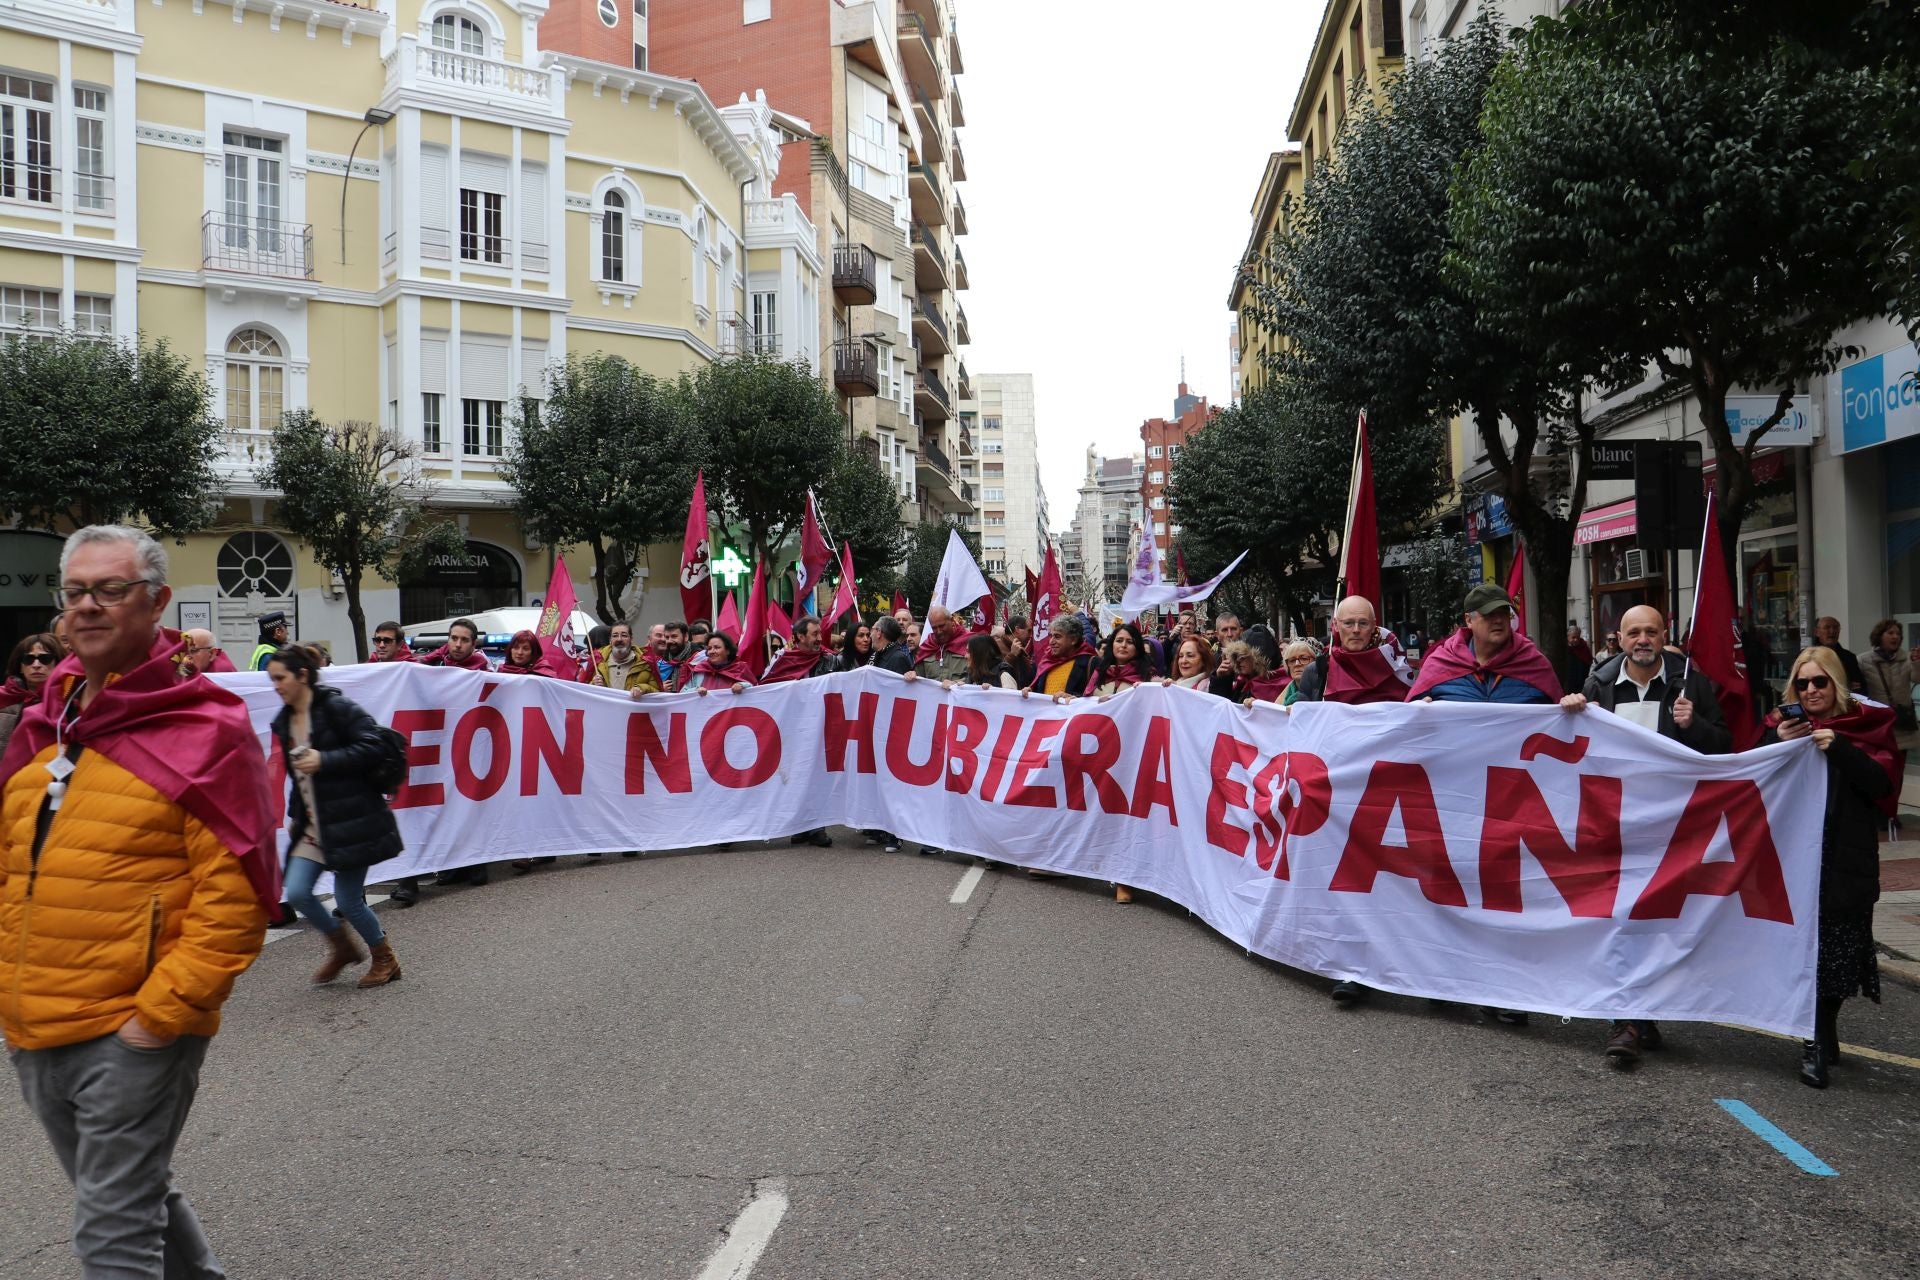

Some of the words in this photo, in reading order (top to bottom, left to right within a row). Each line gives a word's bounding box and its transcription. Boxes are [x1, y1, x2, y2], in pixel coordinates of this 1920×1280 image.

[1577, 525, 1599, 543] POSH
[1410, 634, 1417, 646] P
[625, 707, 782, 795] NO
[823, 691, 1179, 827] HUBIERA
[1205, 732, 1794, 925] ESPAÑA
